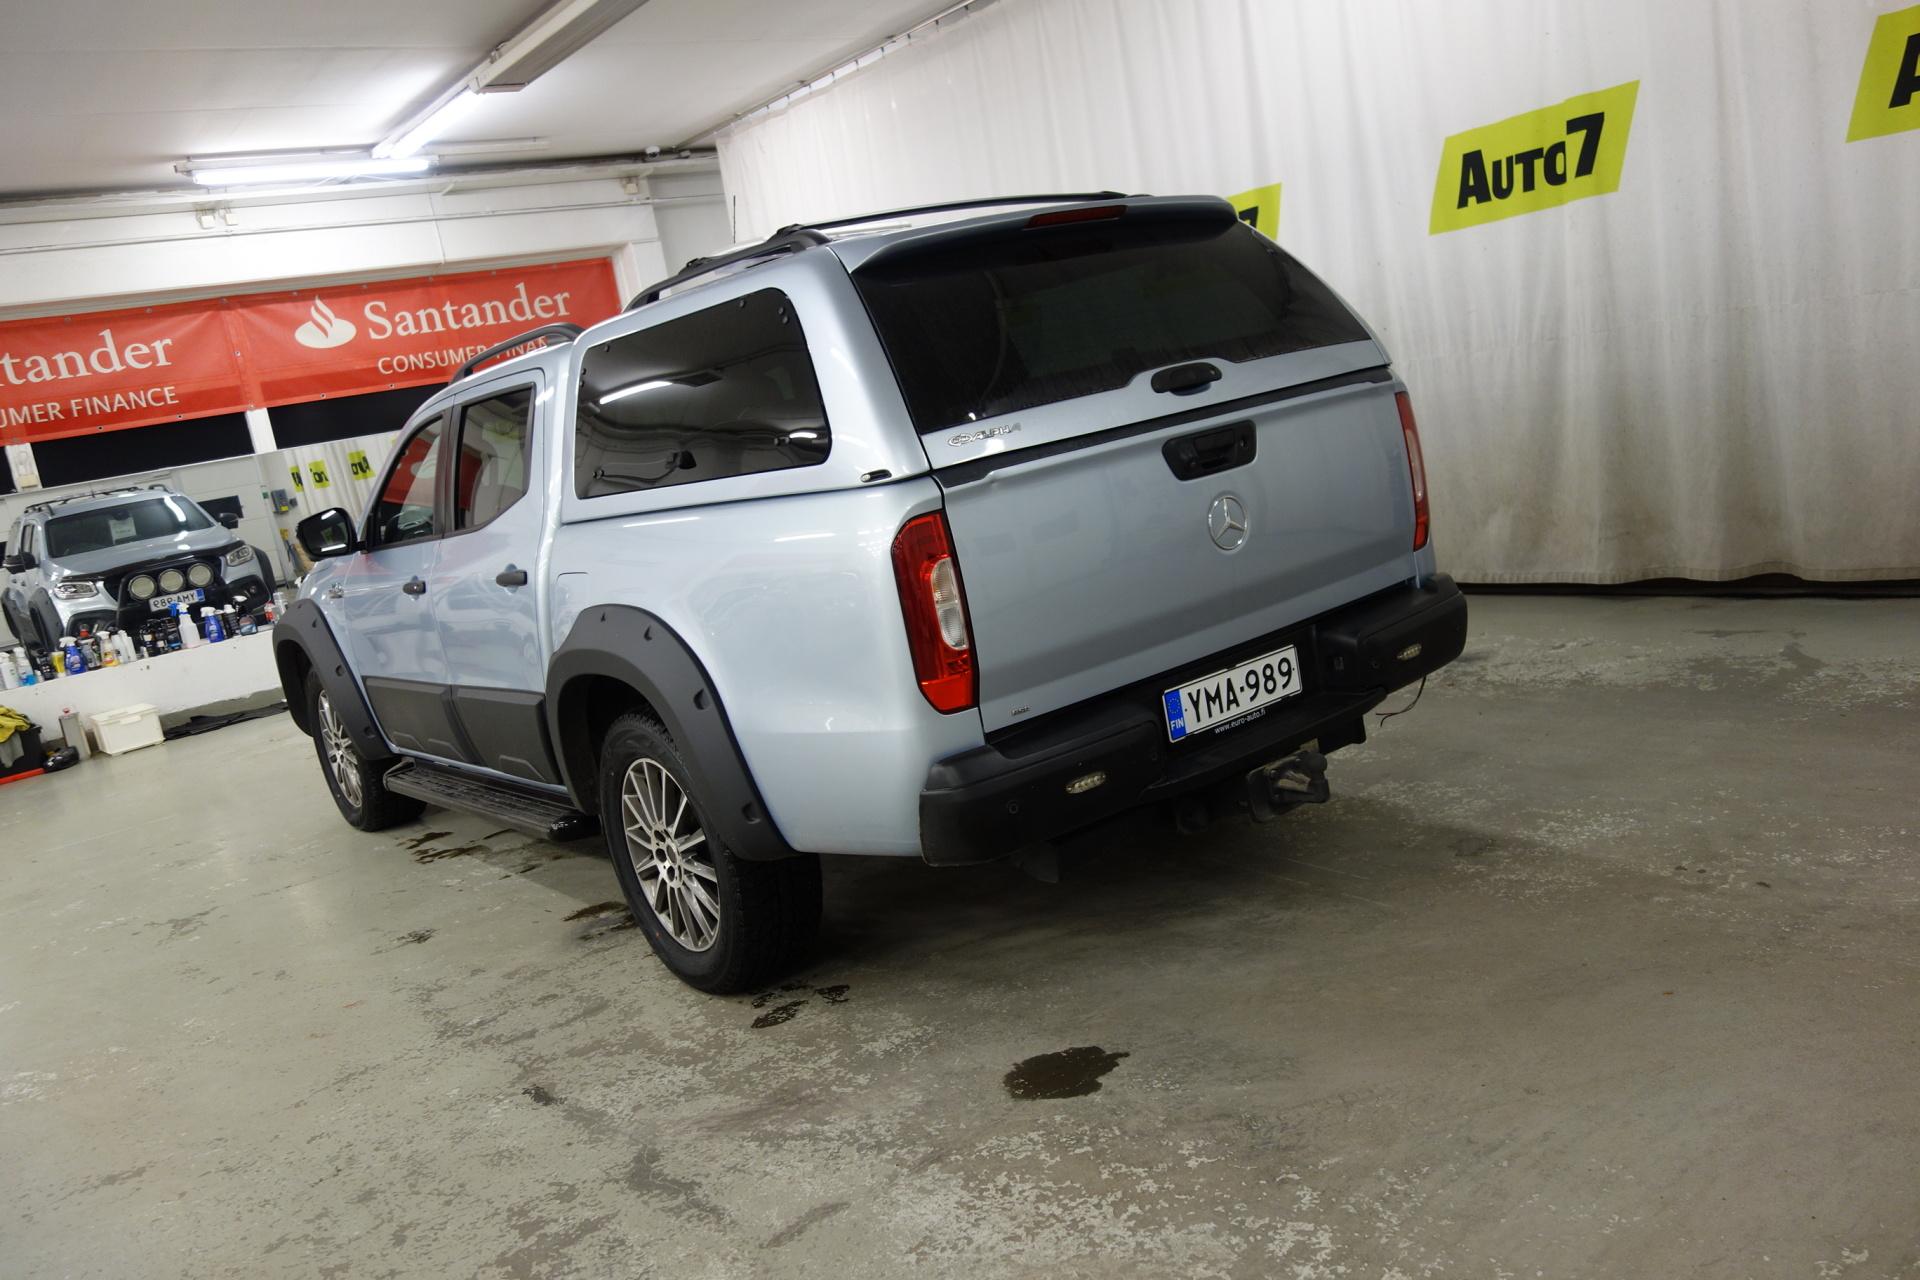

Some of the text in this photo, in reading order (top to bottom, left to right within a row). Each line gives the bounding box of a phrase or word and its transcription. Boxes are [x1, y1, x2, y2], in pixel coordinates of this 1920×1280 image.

[363, 282, 570, 340] Santander
[0, 329, 173, 386] tander
[70, 386, 179, 418] FINANCE
[1170, 657, 1293, 731] FIN YMA-989
[1214, 708, 1266, 734] www.euro-auto.fi
